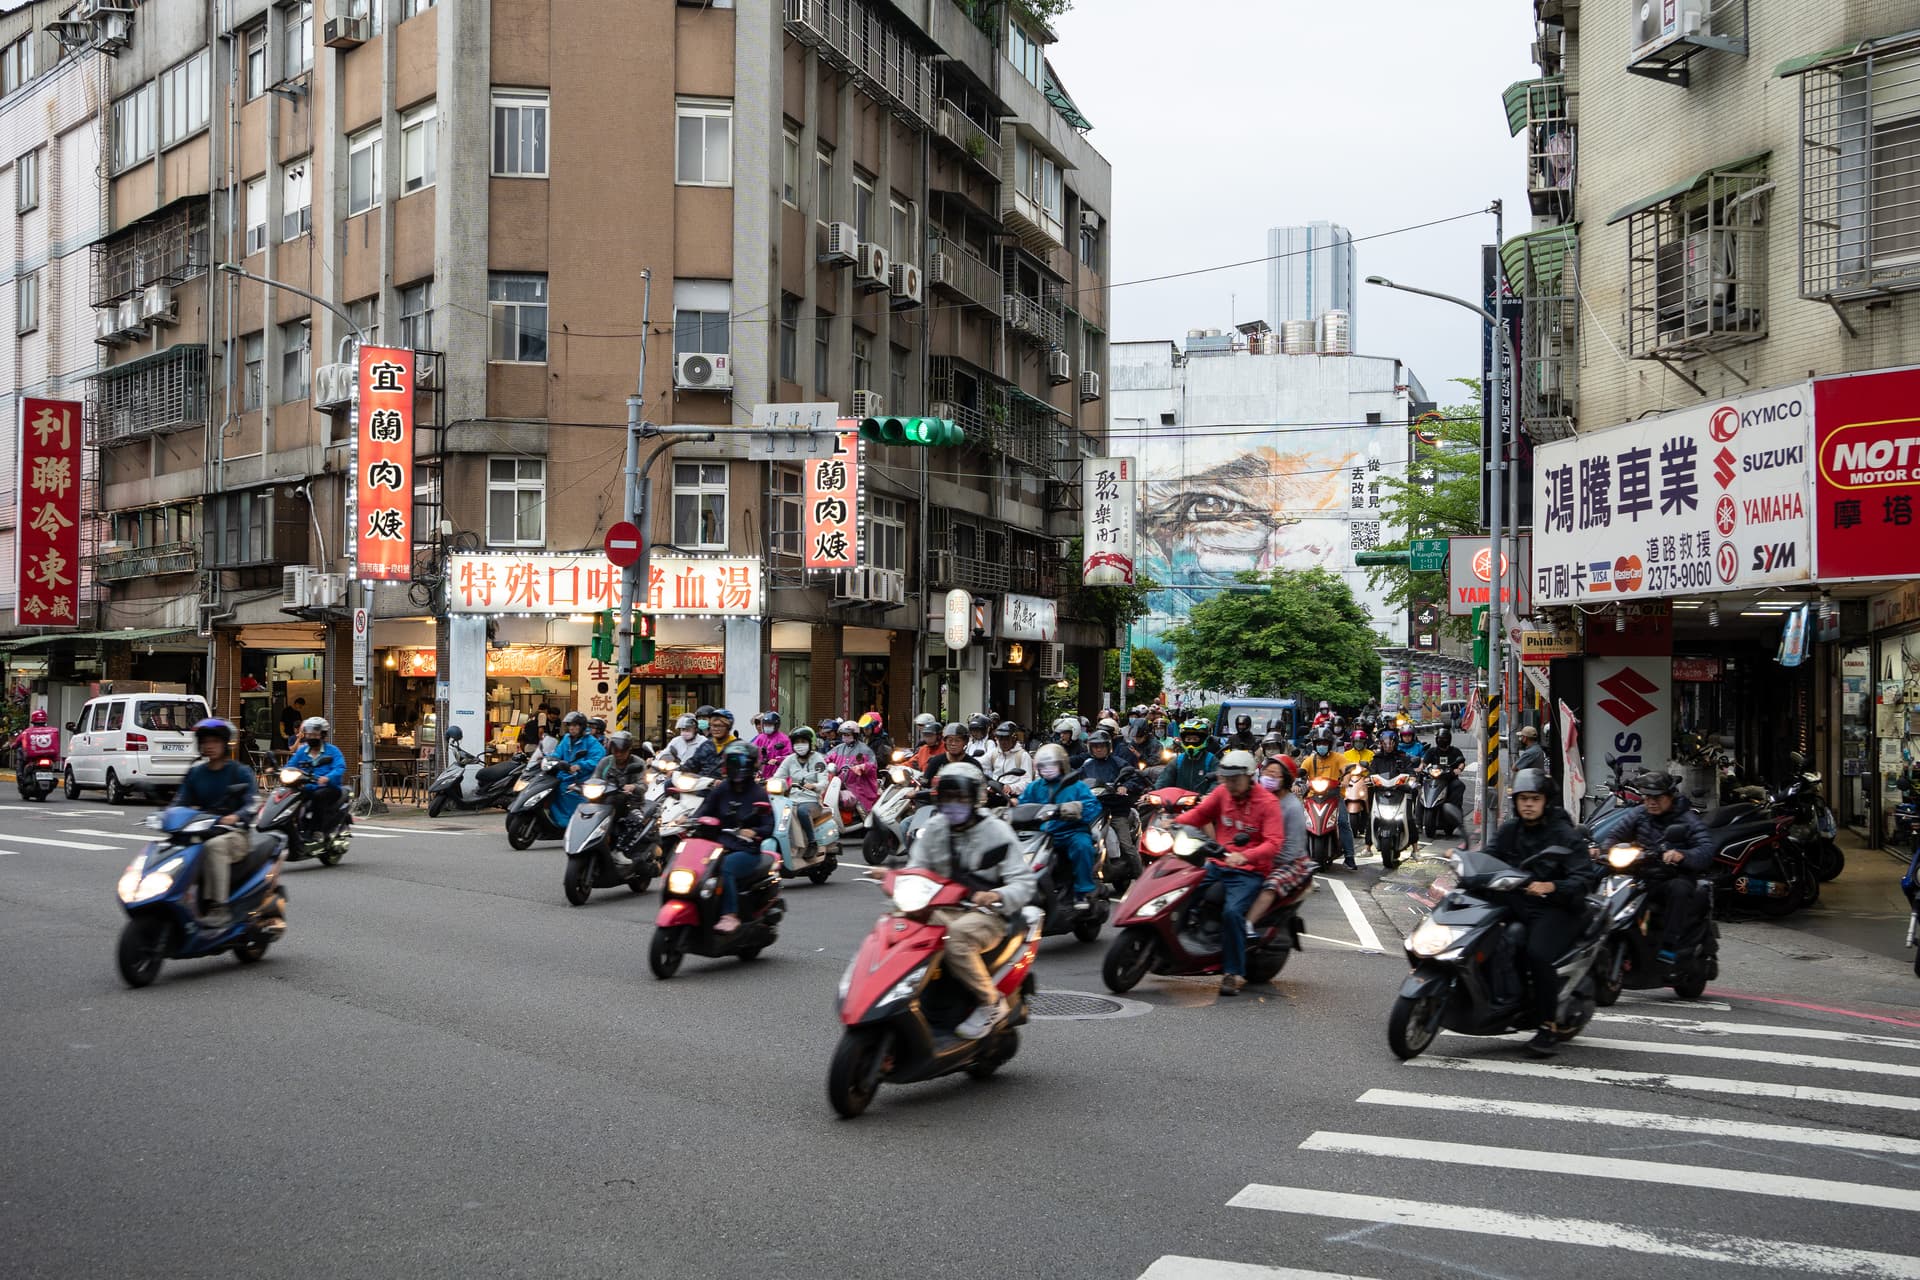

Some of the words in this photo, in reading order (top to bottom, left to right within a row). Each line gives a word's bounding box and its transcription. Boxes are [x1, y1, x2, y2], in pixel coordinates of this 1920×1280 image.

[1502, 399, 1510, 433] MUSIC
[1741, 400, 1802, 428] KYMCO
[366, 361, 405, 541] 宜蘭肉焿
[1743, 445, 1803, 472] SUZUKI
[1832, 437, 1920, 471] MOT
[1351, 467, 1364, 508] 去改變
[1544, 435, 1699, 534] 鴻騰車業
[1850, 469, 1907, 485] MOTOR
[30, 407, 73, 591] 利聯冷凍
[1743, 492, 1803, 525] YAMAHA
[1834, 496, 1912, 529] 摩塔
[1415, 541, 1441, 551] 康定
[1646, 530, 1711, 562] 道路救援
[1751, 542, 1796, 573] SYM
[1537, 561, 1587, 599] 可刷卡
[1592, 570, 1608, 583] VISA
[1648, 561, 1711, 590] 2375-9060
[24, 595, 74, 620] 冷藏
[1458, 587, 1522, 603] YAMH
